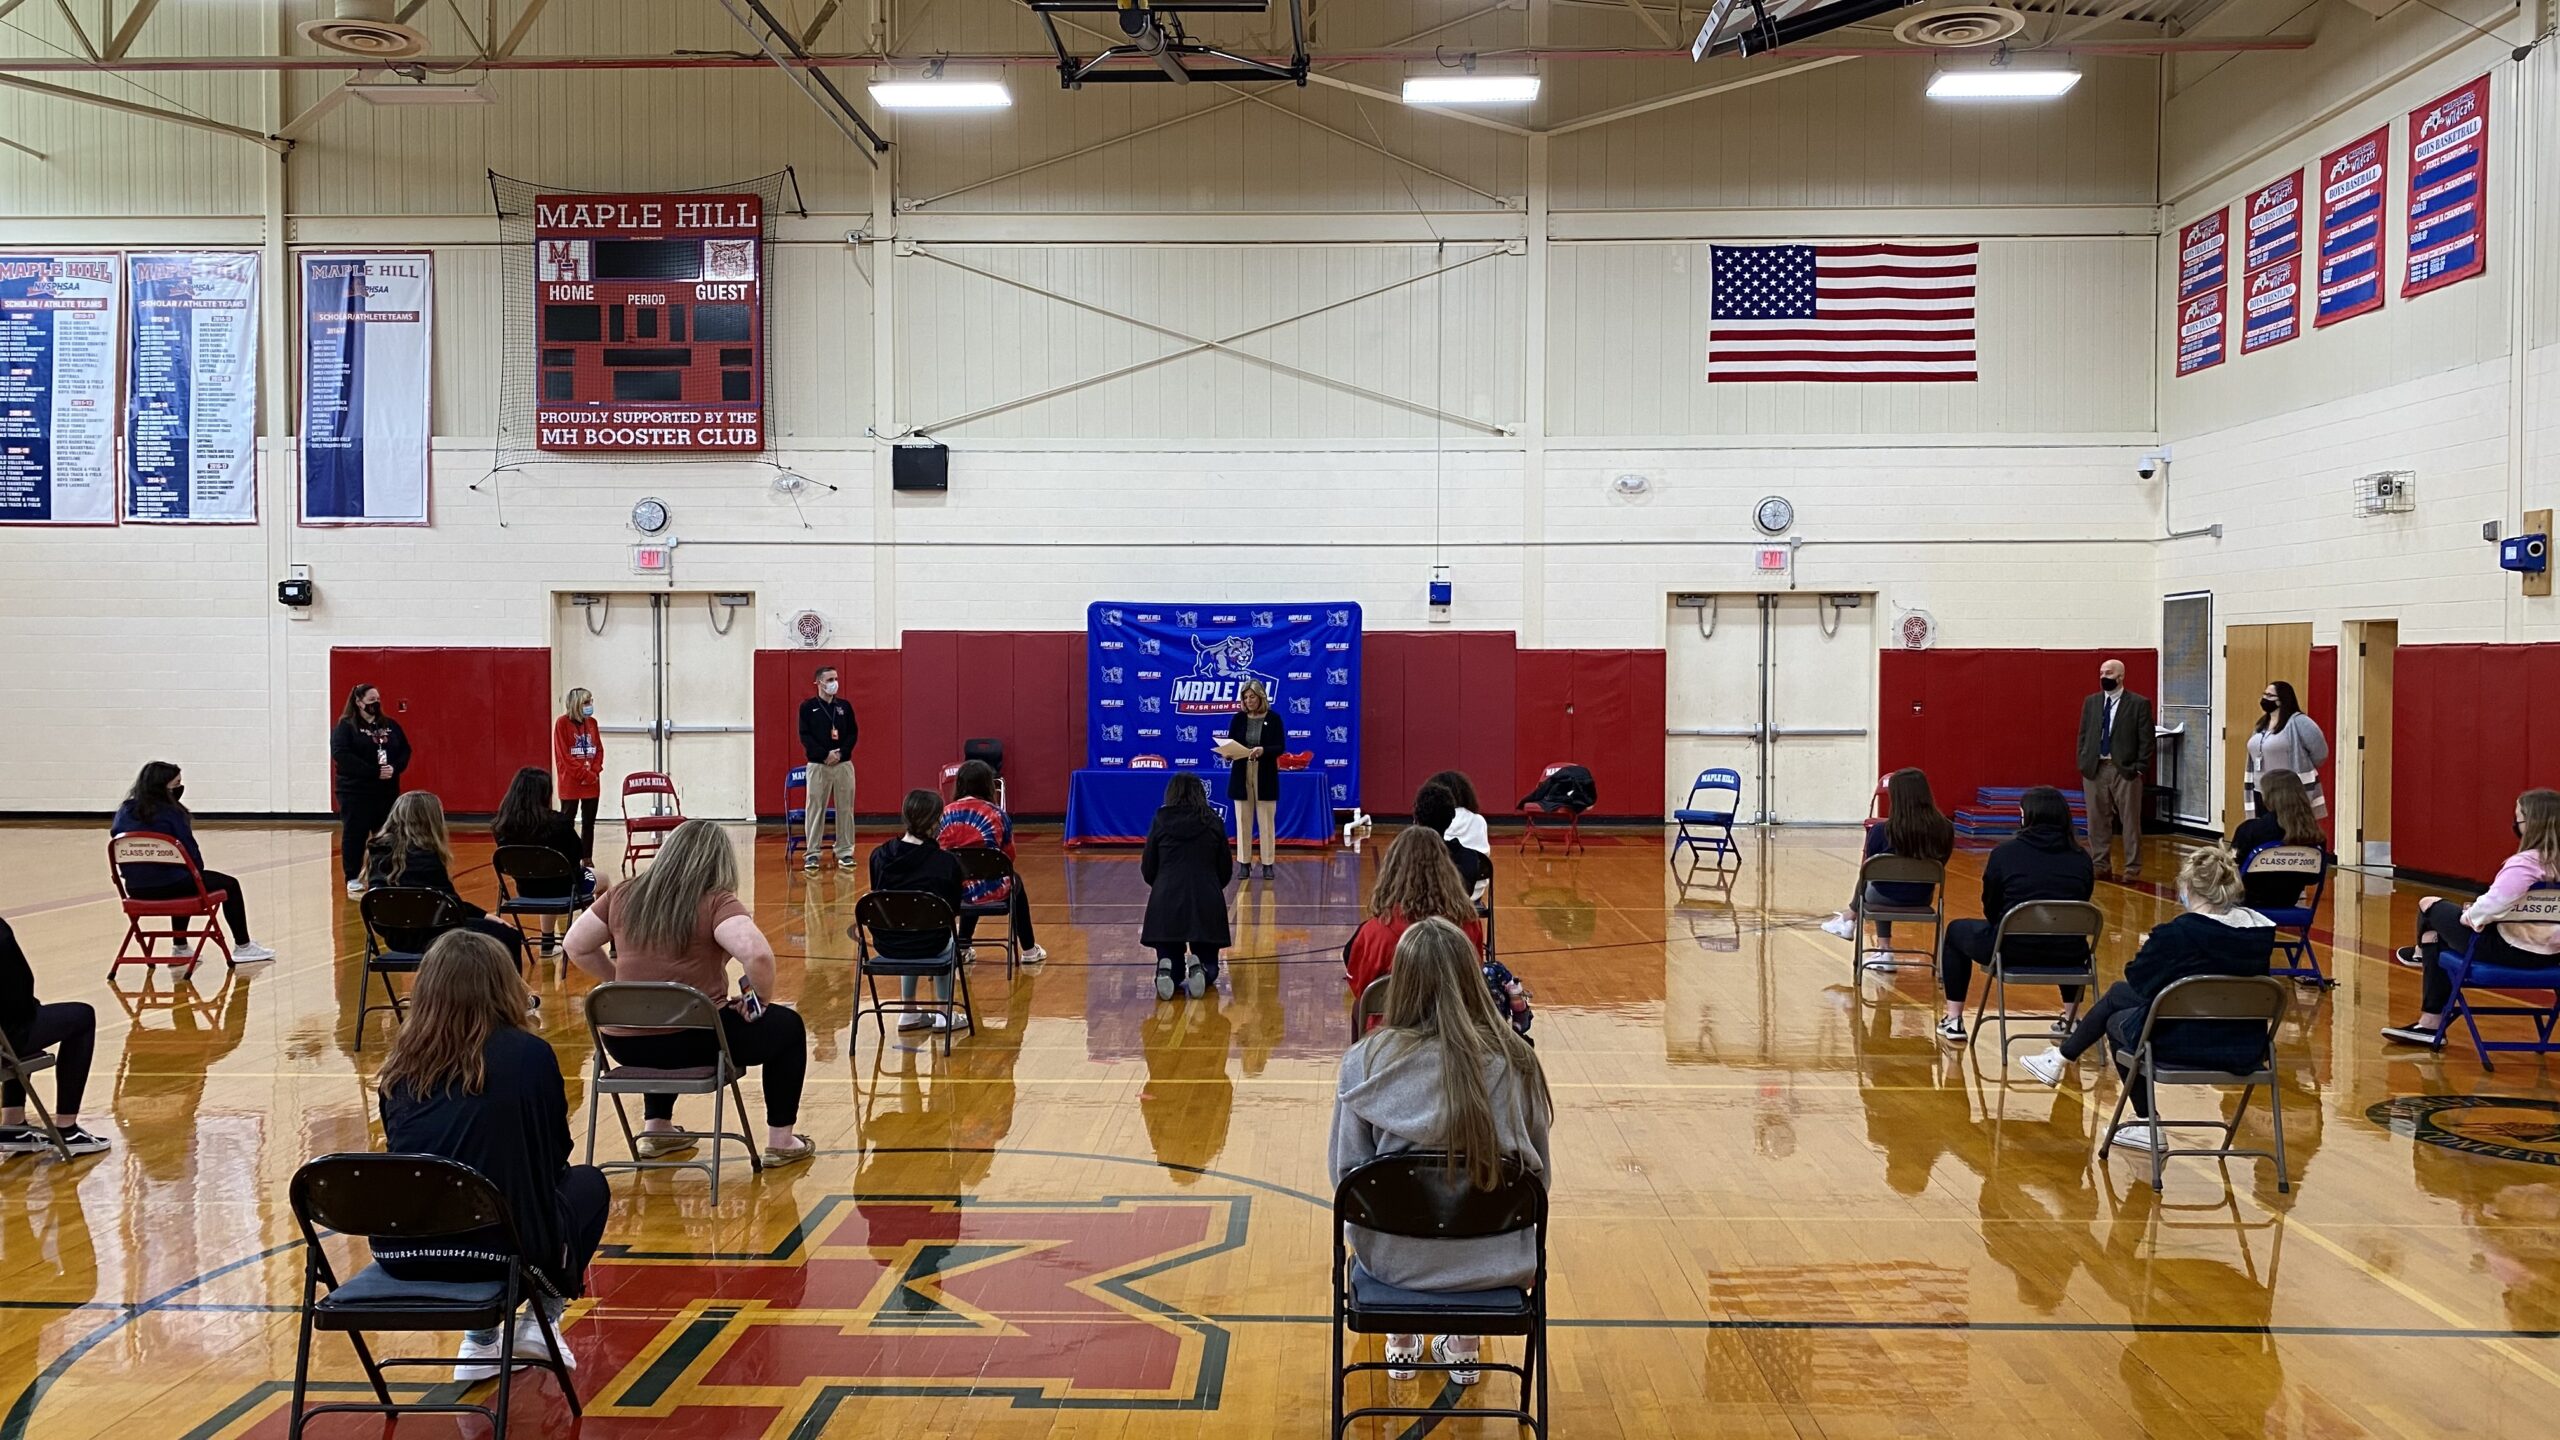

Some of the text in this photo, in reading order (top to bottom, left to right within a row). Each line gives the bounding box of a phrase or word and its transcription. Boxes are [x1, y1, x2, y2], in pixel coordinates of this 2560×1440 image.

[2417, 121, 2478, 158] BOYS BASKETBALL
[2329, 168, 2378, 199] BOYS BASEBALL
[537, 203, 757, 228] MAPLE HILL
[0, 262, 112, 283] MAPLE HILL
[312, 265, 419, 279] MAPLE HILL
[549, 284, 594, 300] HOME
[627, 294, 666, 305] PERIOD
[695, 284, 748, 300] GUEST
[388, 313, 413, 321] TEAMS
[539, 412, 757, 424] PROUDLY SUPPORTED BY THE
[541, 428, 757, 445] MH BOOSTER CLUB
[641, 550, 661, 566] EXIT
[1763, 551, 1784, 567] EXIT
[1174, 681, 1235, 702] MAPLE
[629, 777, 667, 788] MAPLE HILL
[1701, 774, 1735, 784] MAPLE HILL
[2260, 857, 2286, 865] CLASS
[2288, 858, 2299, 866] OF
[2544, 905, 2558, 913] OF
[419, 1249, 454, 1257] ARMOUR
